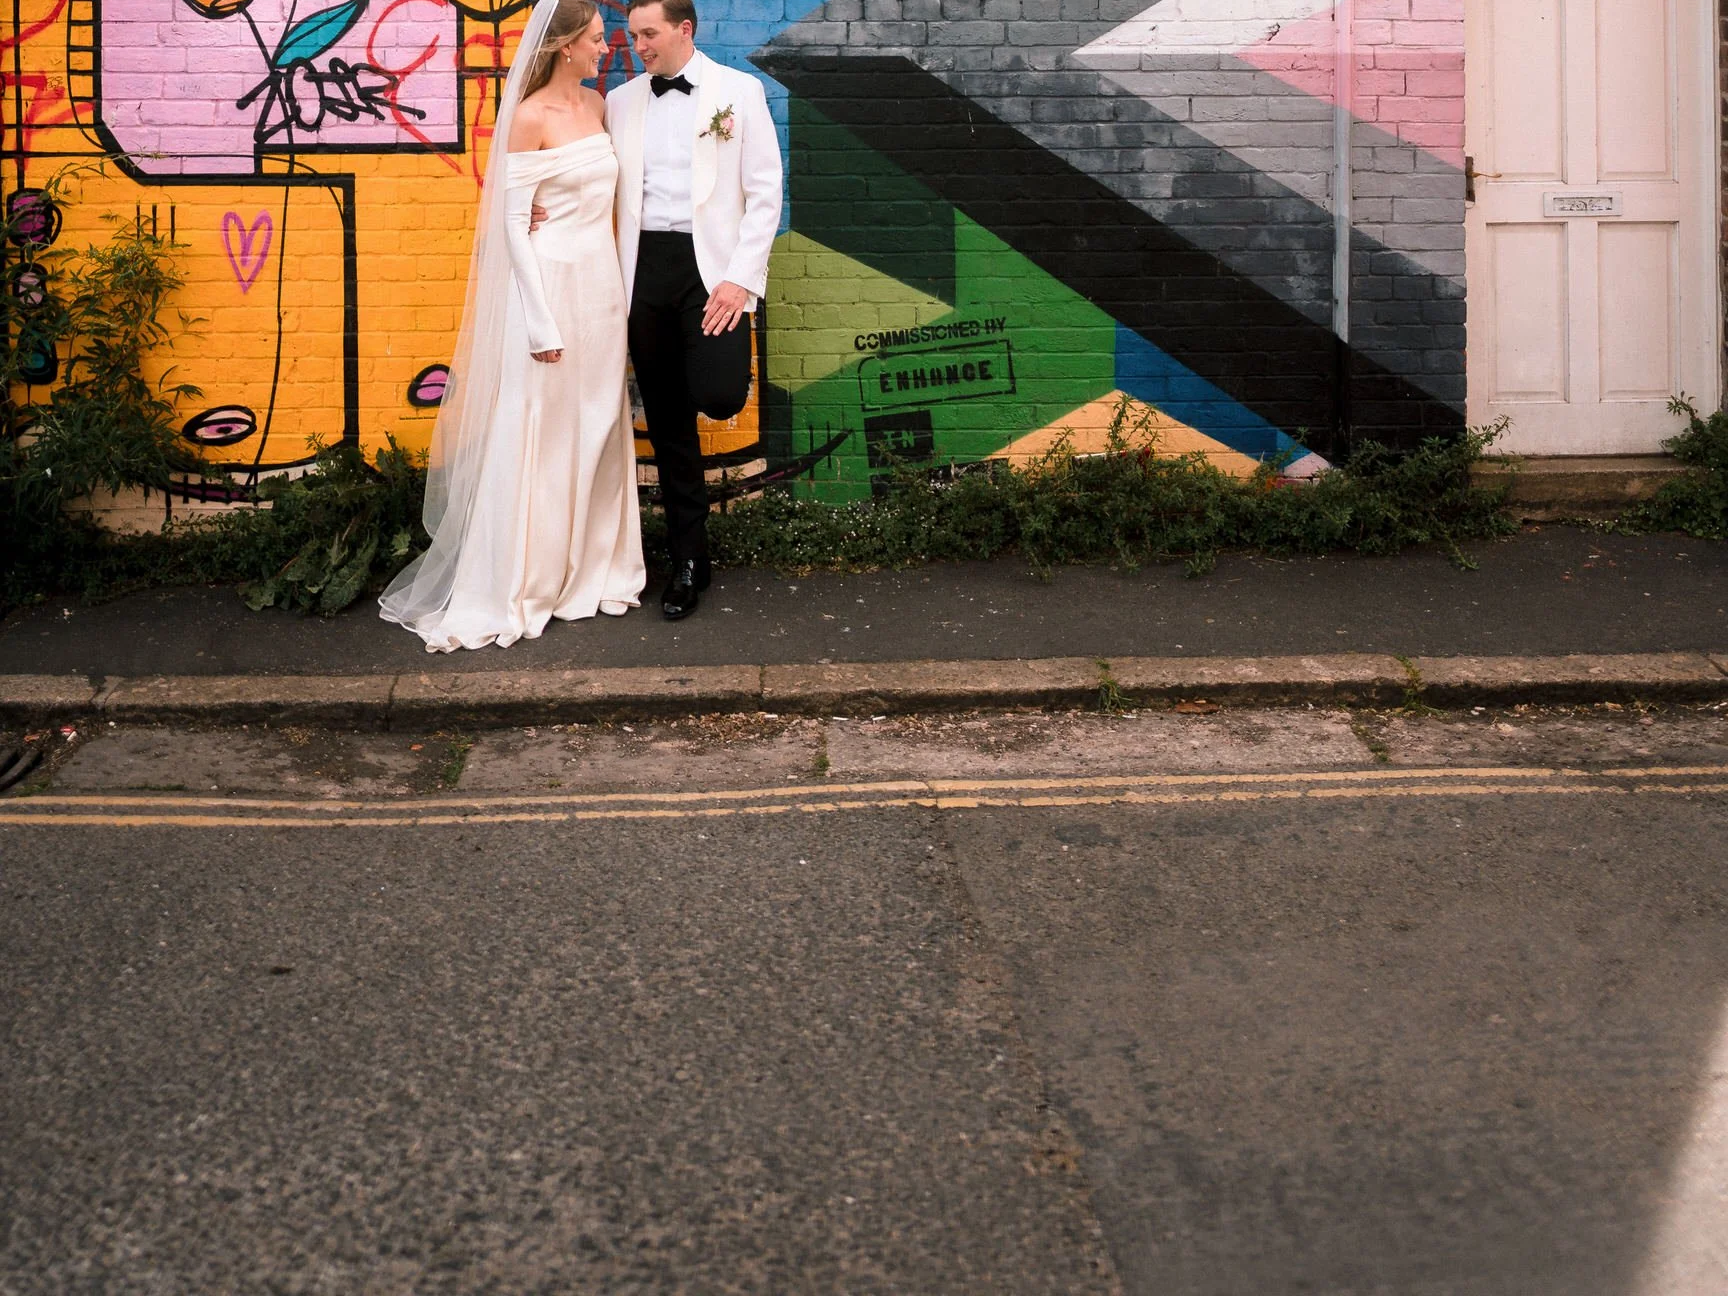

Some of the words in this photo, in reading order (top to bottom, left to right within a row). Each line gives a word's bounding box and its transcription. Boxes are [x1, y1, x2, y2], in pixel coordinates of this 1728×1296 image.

[854, 320, 980, 350] COMMISSIONED
[984, 316, 1007, 334] BY
[880, 360, 993, 394] ENHANCE
